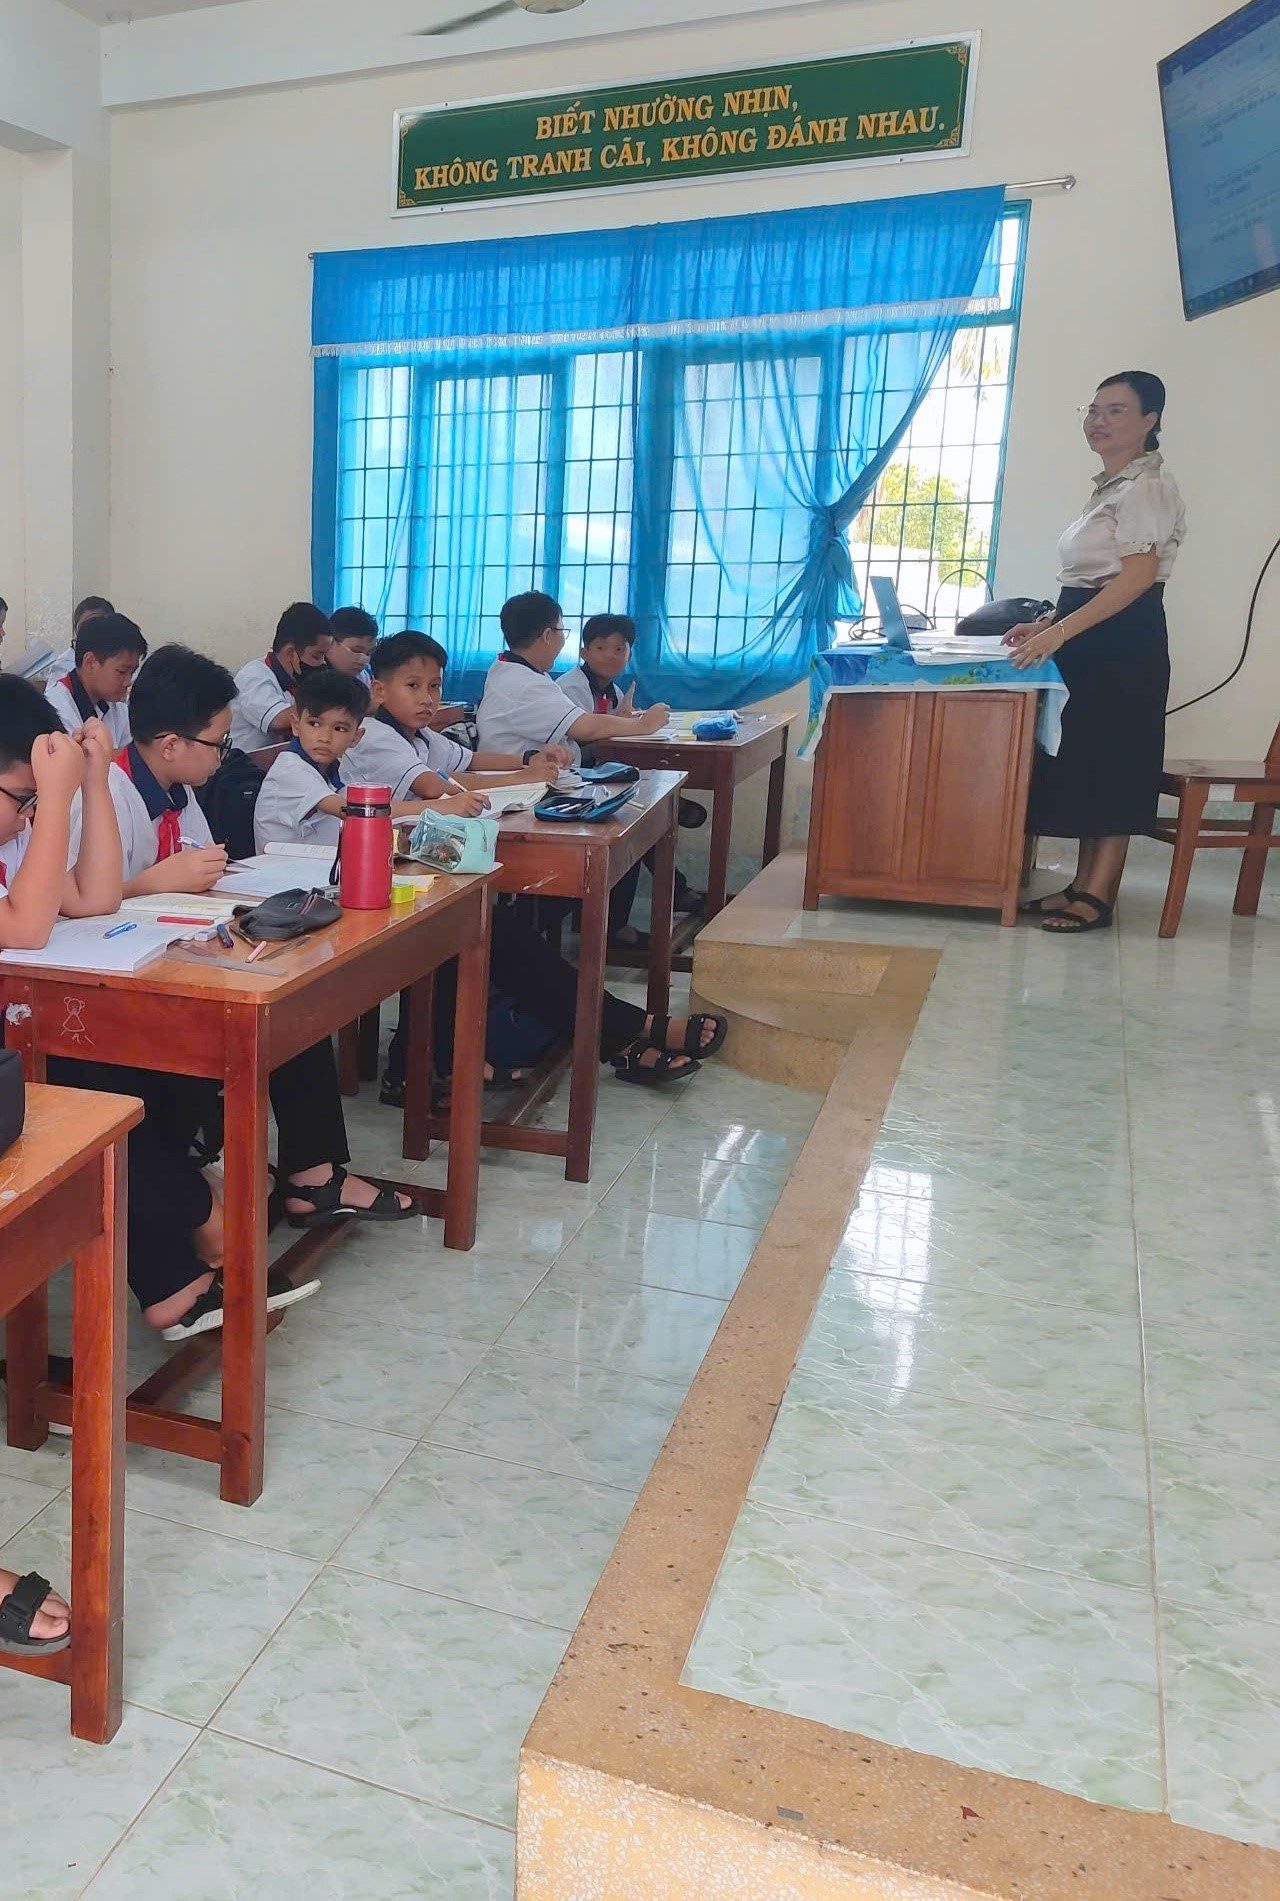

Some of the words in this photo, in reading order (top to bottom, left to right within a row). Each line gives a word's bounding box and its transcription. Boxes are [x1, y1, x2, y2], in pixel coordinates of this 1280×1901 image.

[535, 101, 596, 140] BIẾT
[603, 93, 714, 132] NHƯỜNG
[722, 84, 799, 118] NHỊN,
[414, 157, 498, 190] KHÔNG
[506, 147, 593, 180] TRANH
[599, 136, 652, 169] CÃI,
[661, 126, 758, 162] KHÔNG
[766, 115, 849, 150] ĐÁNH
[855, 106, 946, 140] NHAU.
